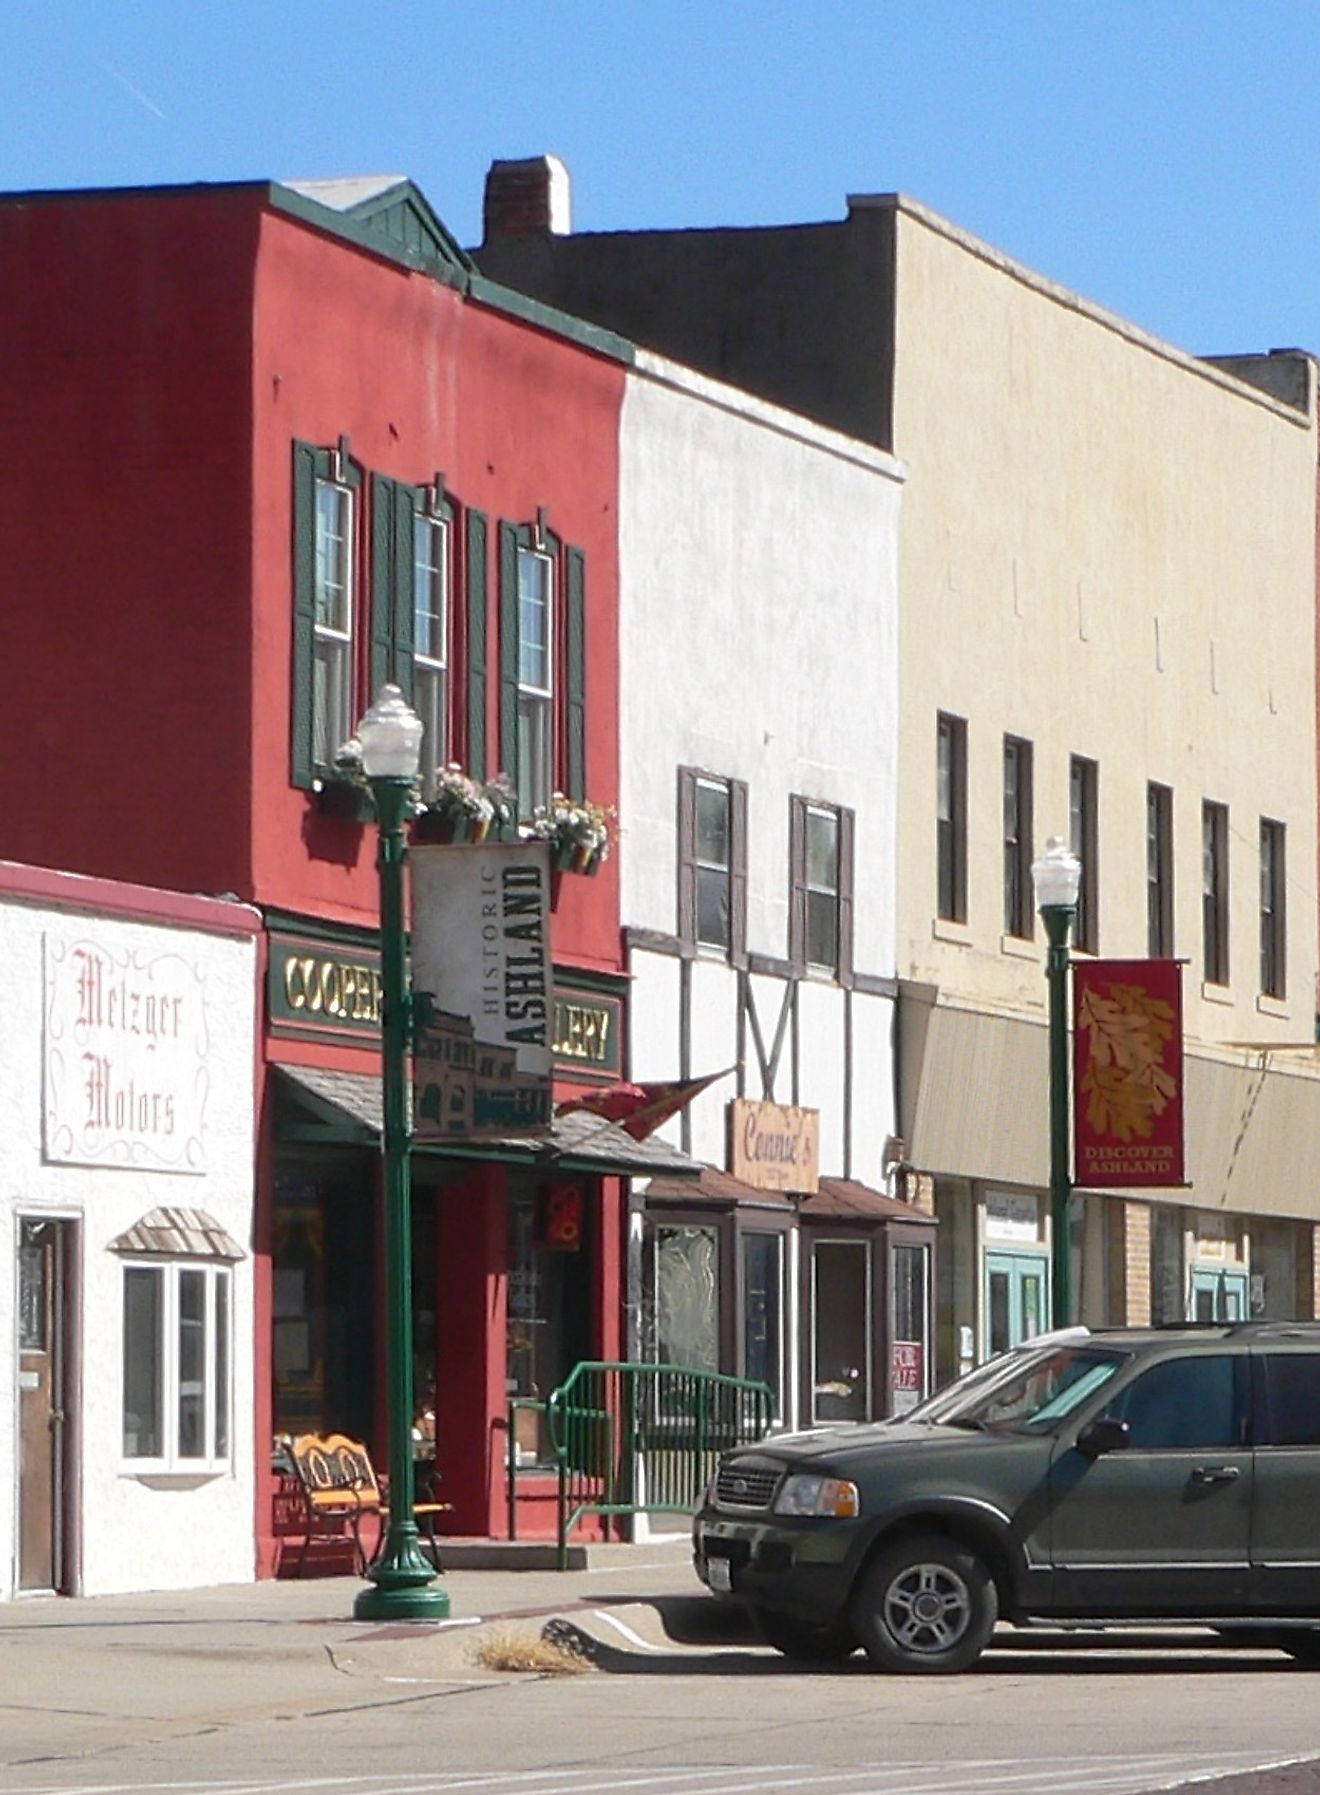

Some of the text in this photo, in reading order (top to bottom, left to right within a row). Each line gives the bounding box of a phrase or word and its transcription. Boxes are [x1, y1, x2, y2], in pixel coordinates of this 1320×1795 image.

[482, 864, 499, 1015] HISTORIC
[502, 865, 546, 1047] ASHLAND
[74, 948, 183, 1051] Metzger
[82, 1051, 176, 1136] Motors
[1084, 1145, 1175, 1159] DISCOVER
[1089, 1160, 1170, 1174] ASHLAND
[893, 1346, 916, 1367] FOR
